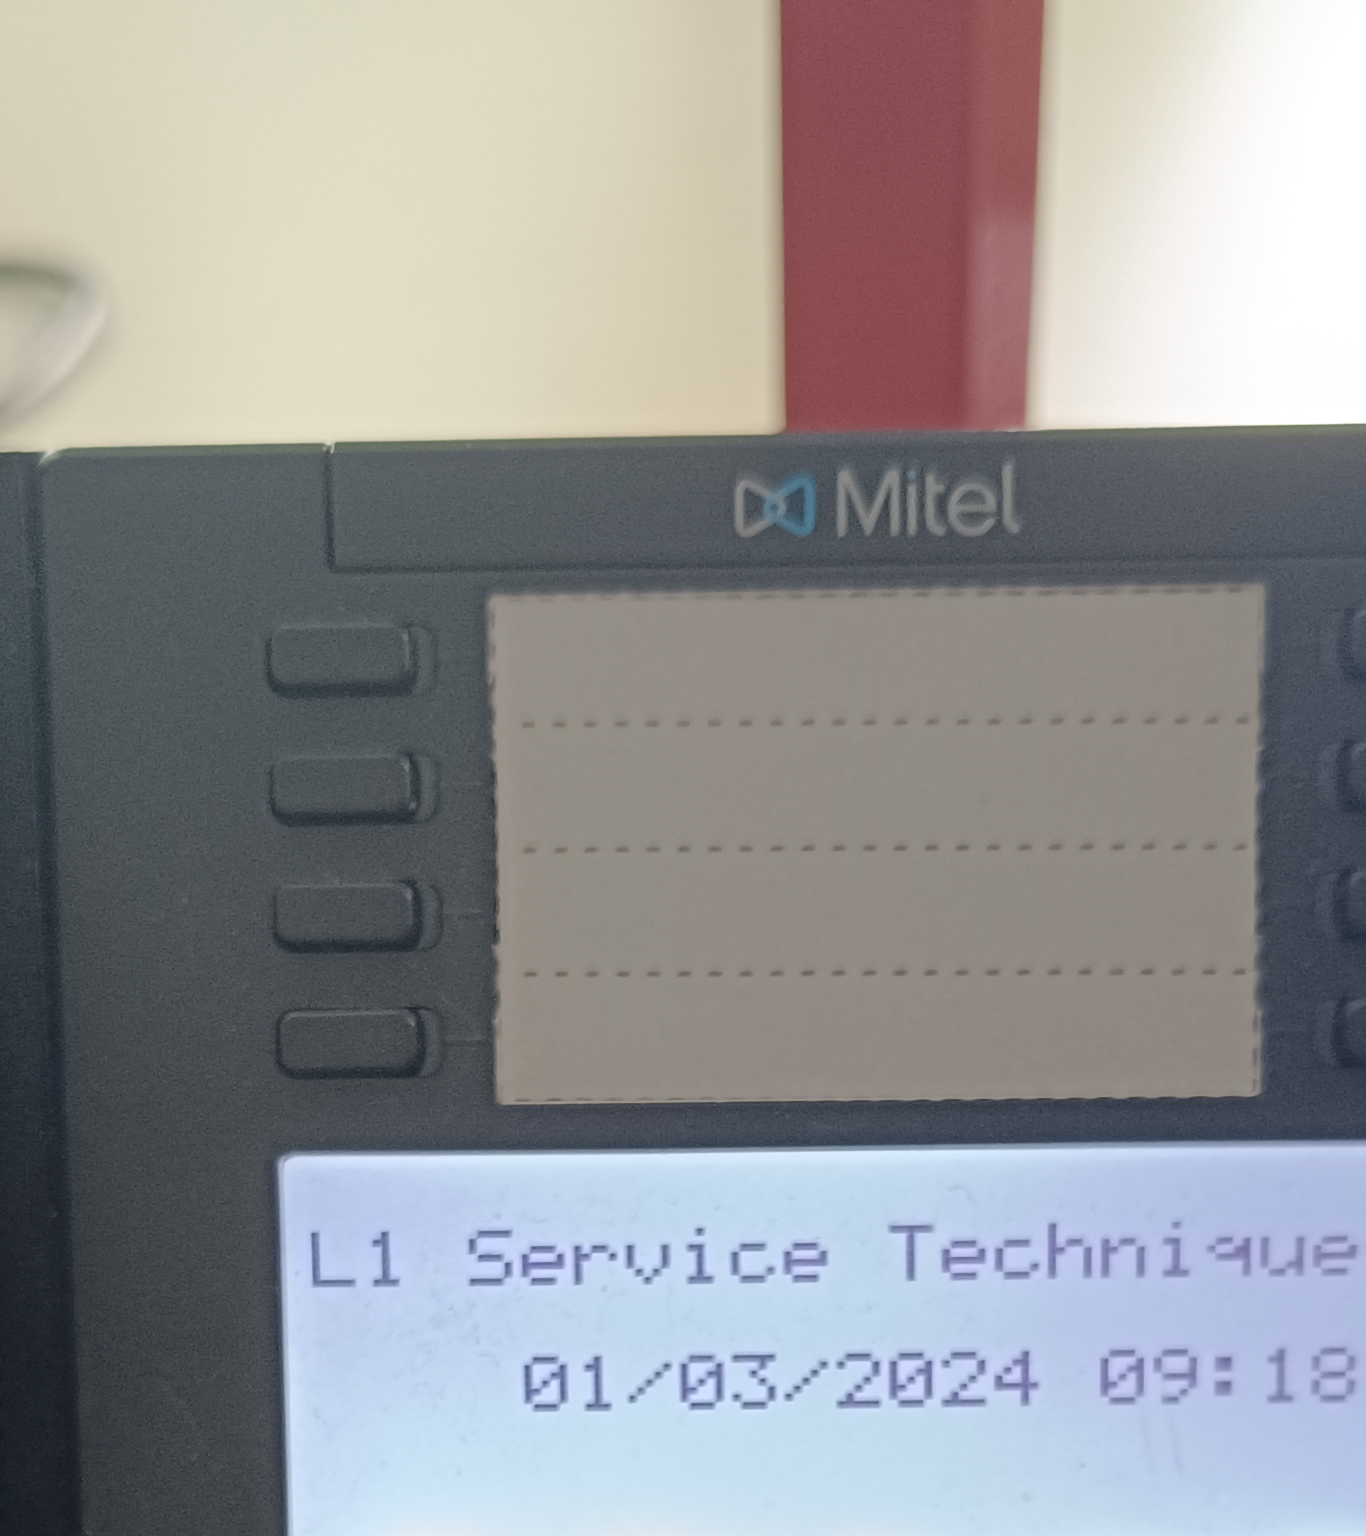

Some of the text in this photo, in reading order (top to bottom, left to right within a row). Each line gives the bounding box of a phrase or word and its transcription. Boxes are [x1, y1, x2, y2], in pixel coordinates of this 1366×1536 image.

[836, 463, 1021, 538] Mitel
[309, 1221, 1359, 1288] L1 Service Technique
[523, 1346, 1357, 1412] 01/03/2024 09:18
